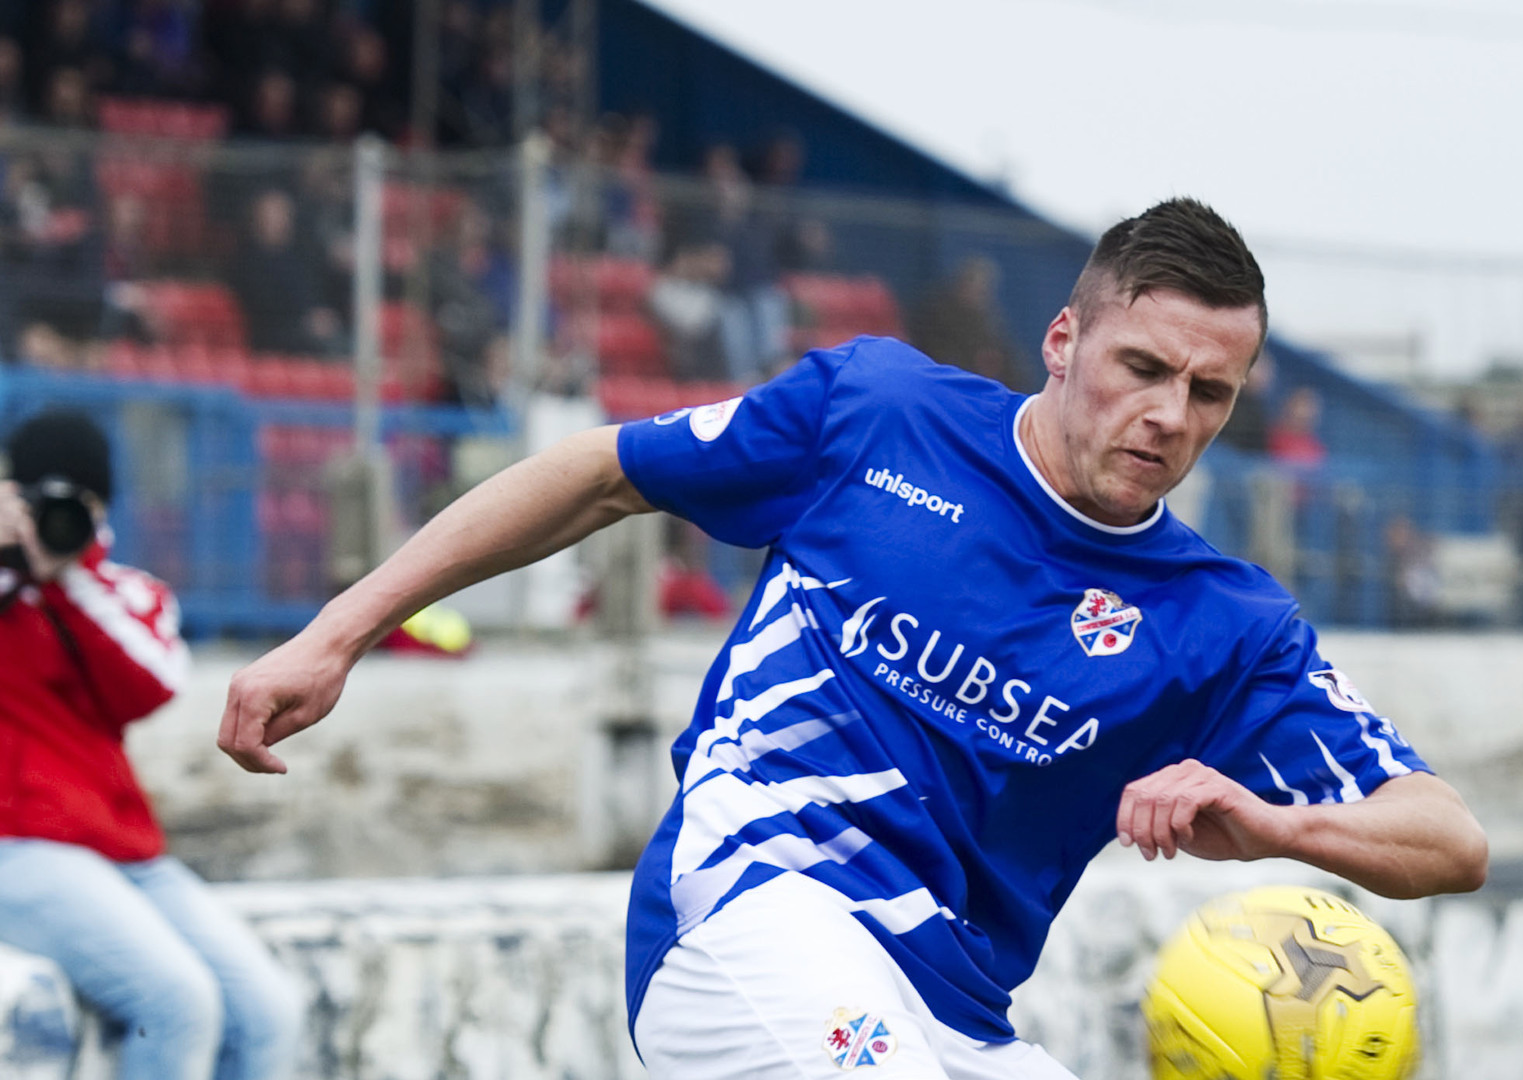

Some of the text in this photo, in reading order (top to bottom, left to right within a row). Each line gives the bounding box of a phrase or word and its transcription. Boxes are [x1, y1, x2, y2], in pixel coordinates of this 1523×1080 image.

[864, 467, 964, 524] uhlsport
[873, 662, 1053, 767] PRESSURE CONTRO
[876, 612, 1100, 755] SUBSEA
